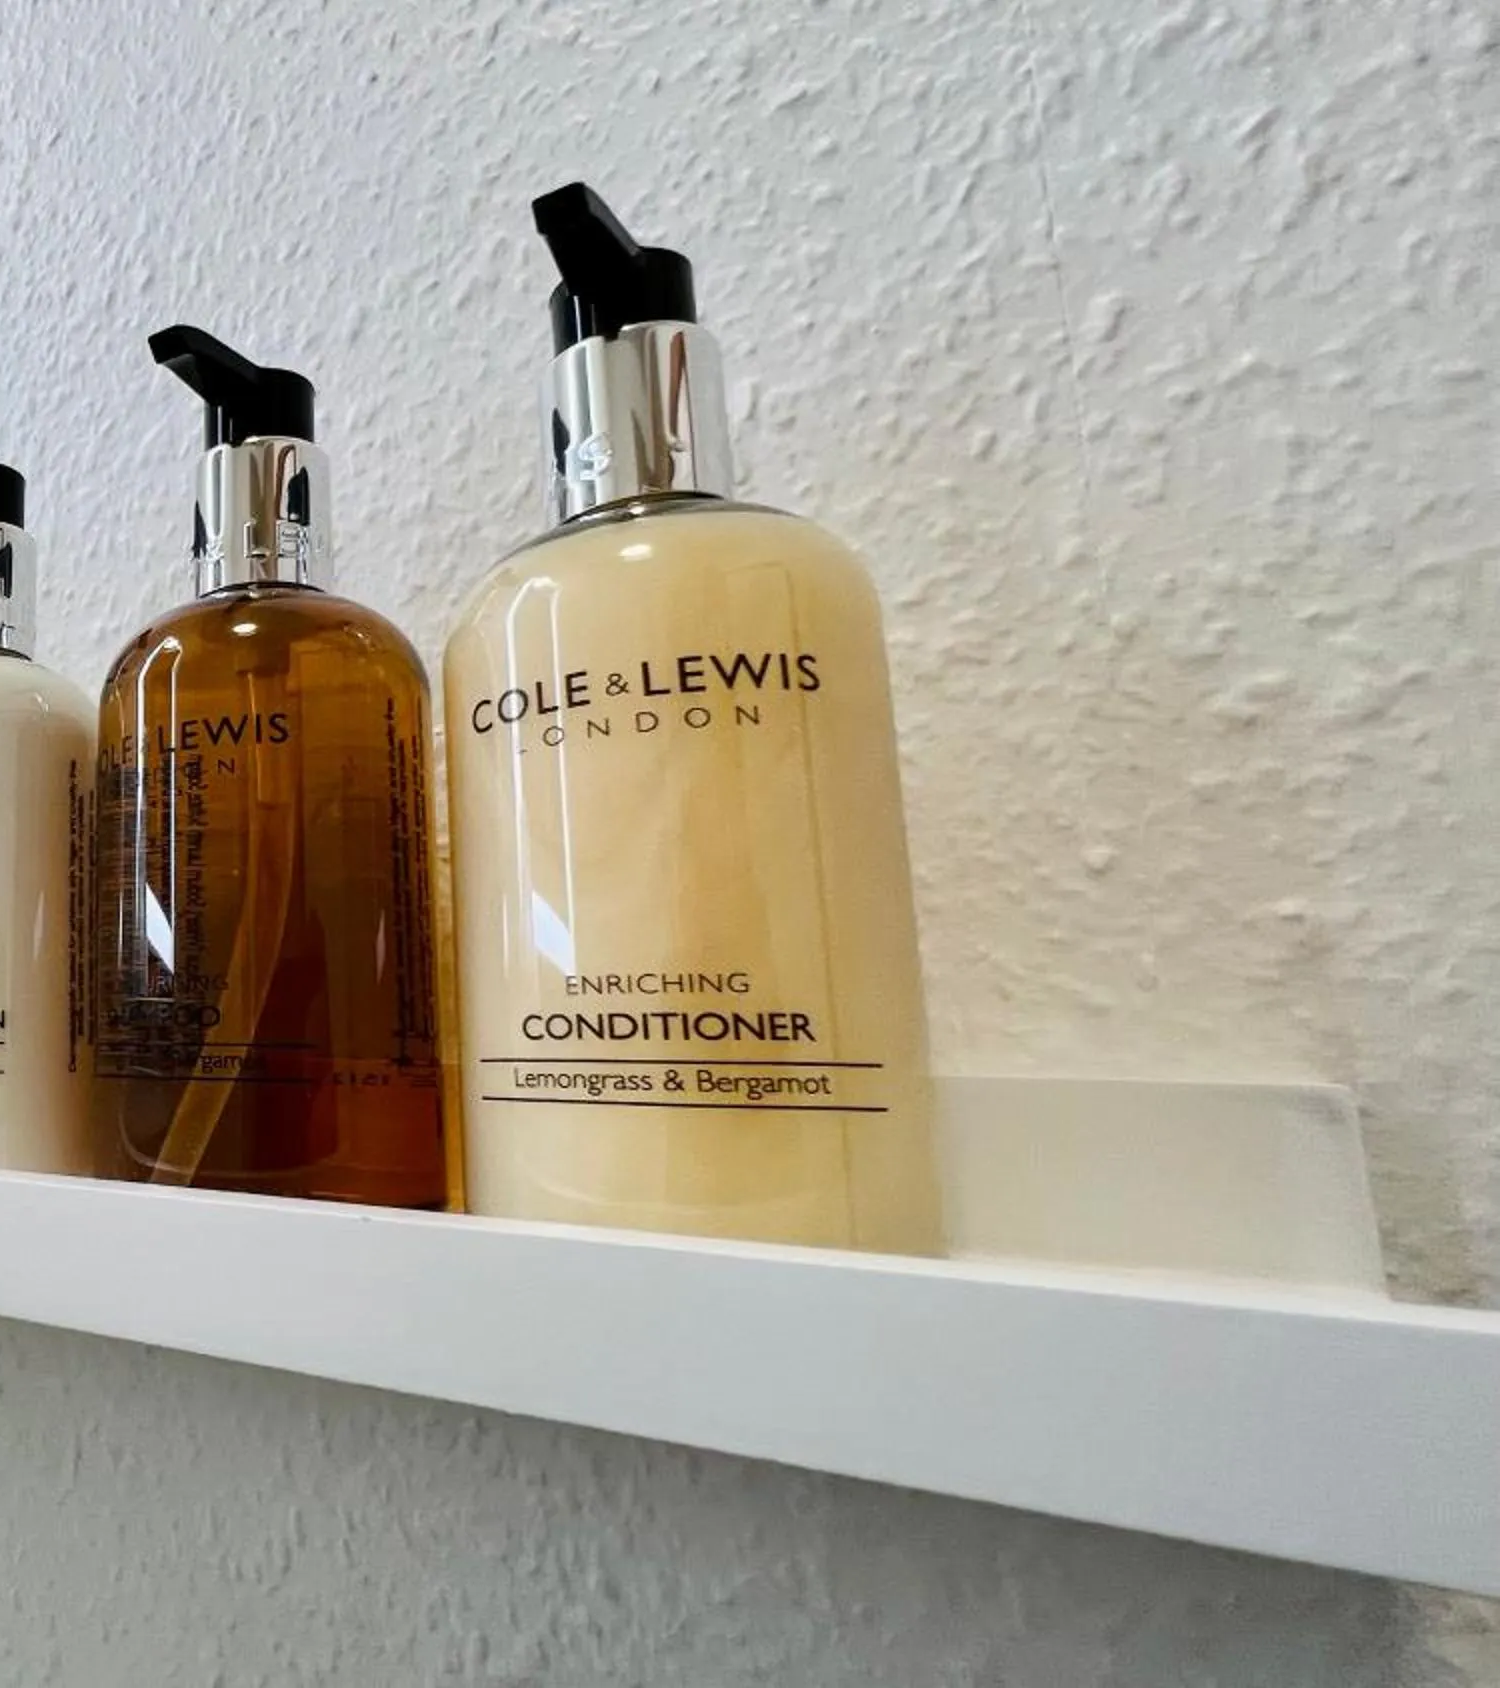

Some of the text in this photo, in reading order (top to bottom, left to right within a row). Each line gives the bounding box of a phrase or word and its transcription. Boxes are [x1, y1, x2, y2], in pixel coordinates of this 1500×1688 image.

[471, 652, 822, 735] COLE & LEWIS
[157, 712, 290, 755] LEWIS
[517, 705, 761, 755] ONDON
[565, 972, 752, 997] ENRICHING
[521, 1012, 817, 1043] CONDITIONER
[514, 1067, 832, 1101] Lemongrass & Bergamot
